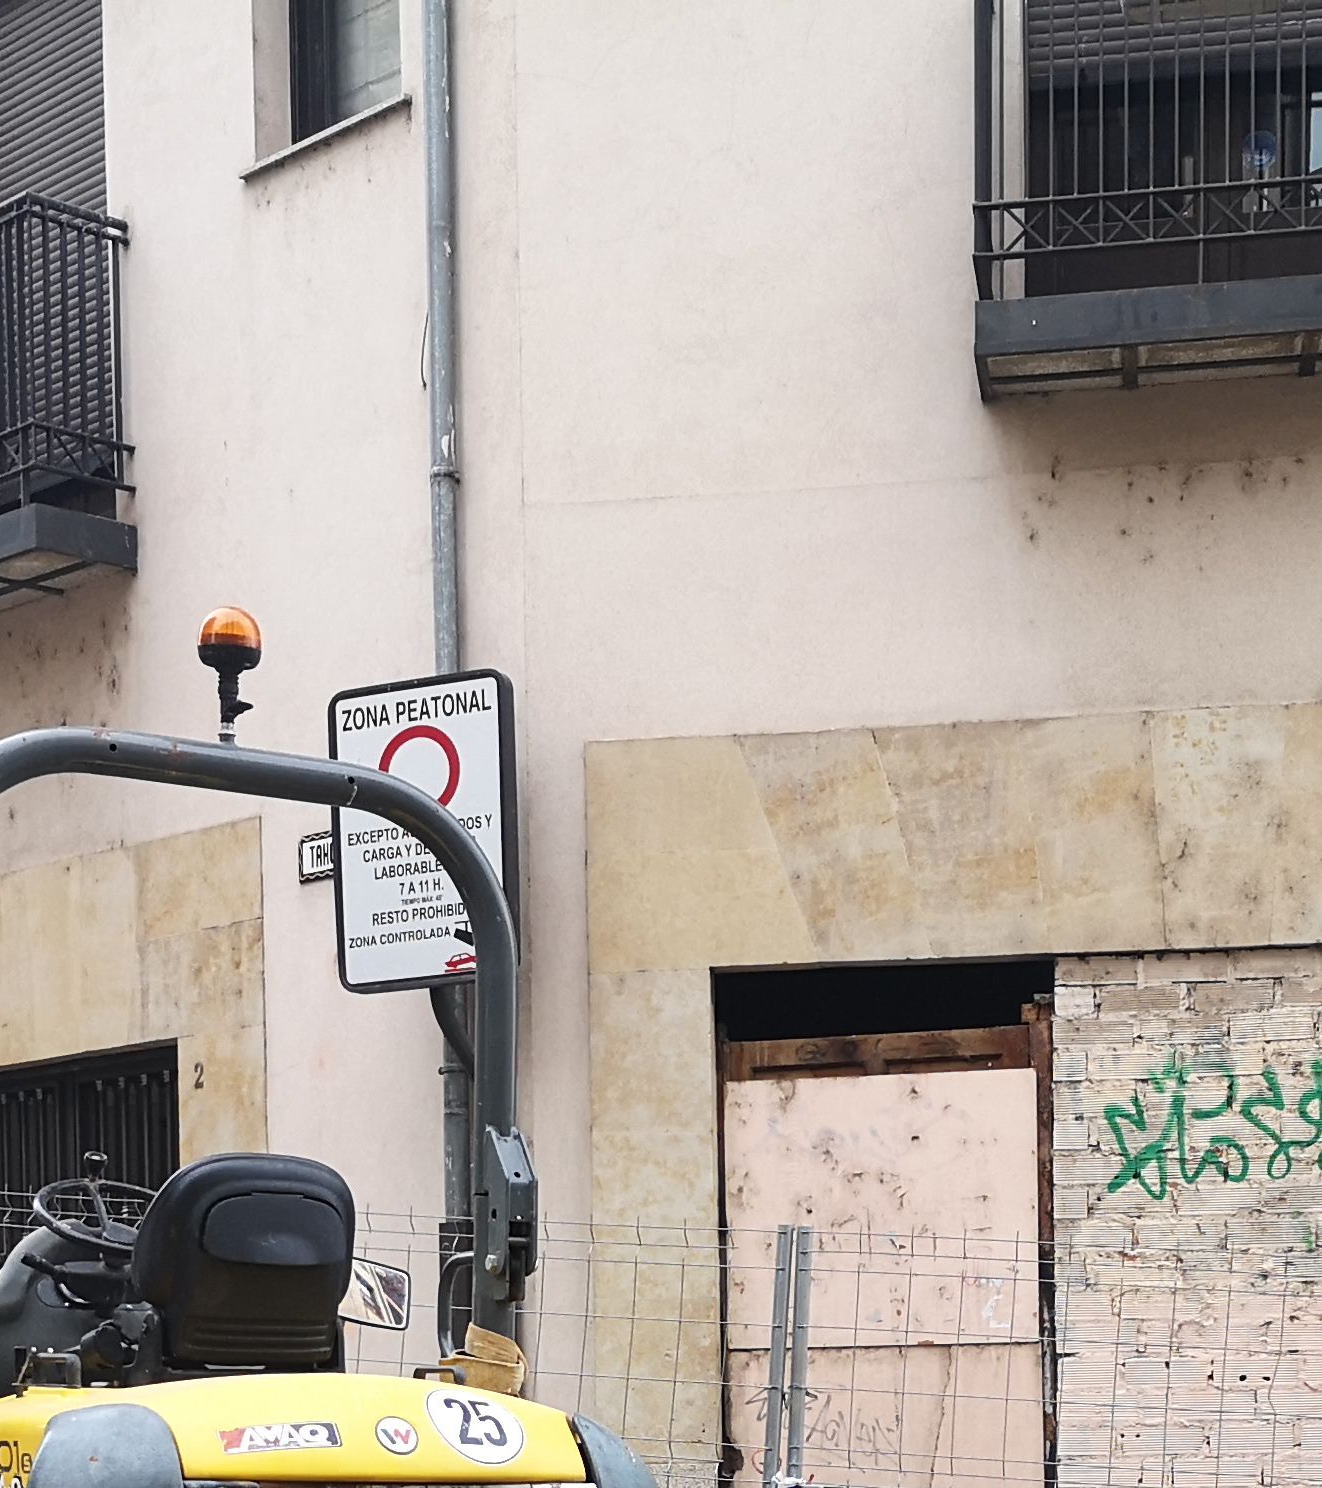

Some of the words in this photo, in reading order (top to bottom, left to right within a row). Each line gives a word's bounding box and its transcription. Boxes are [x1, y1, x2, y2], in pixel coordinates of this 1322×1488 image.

[342, 706, 390, 732] ZONA
[395, 688, 492, 725] PEATONAL
[347, 827, 399, 846] EXCEPTO
[363, 845, 402, 863] CARGA
[405, 844, 413, 858] Y
[374, 859, 445, 880] LABORABLE
[399, 882, 405, 896] 7
[408, 881, 416, 895] A
[418, 879, 429, 893] 11
[372, 908, 409, 926] RESTO
[412, 902, 466, 922] PROHIBID
[349, 936, 377, 949] ZONA
[380, 926, 451, 945] CONTROLADA
[193, 1061, 205, 1090] 2
[443, 1396, 508, 1447] 25
[233, 1424, 333, 1451] AMAQ
